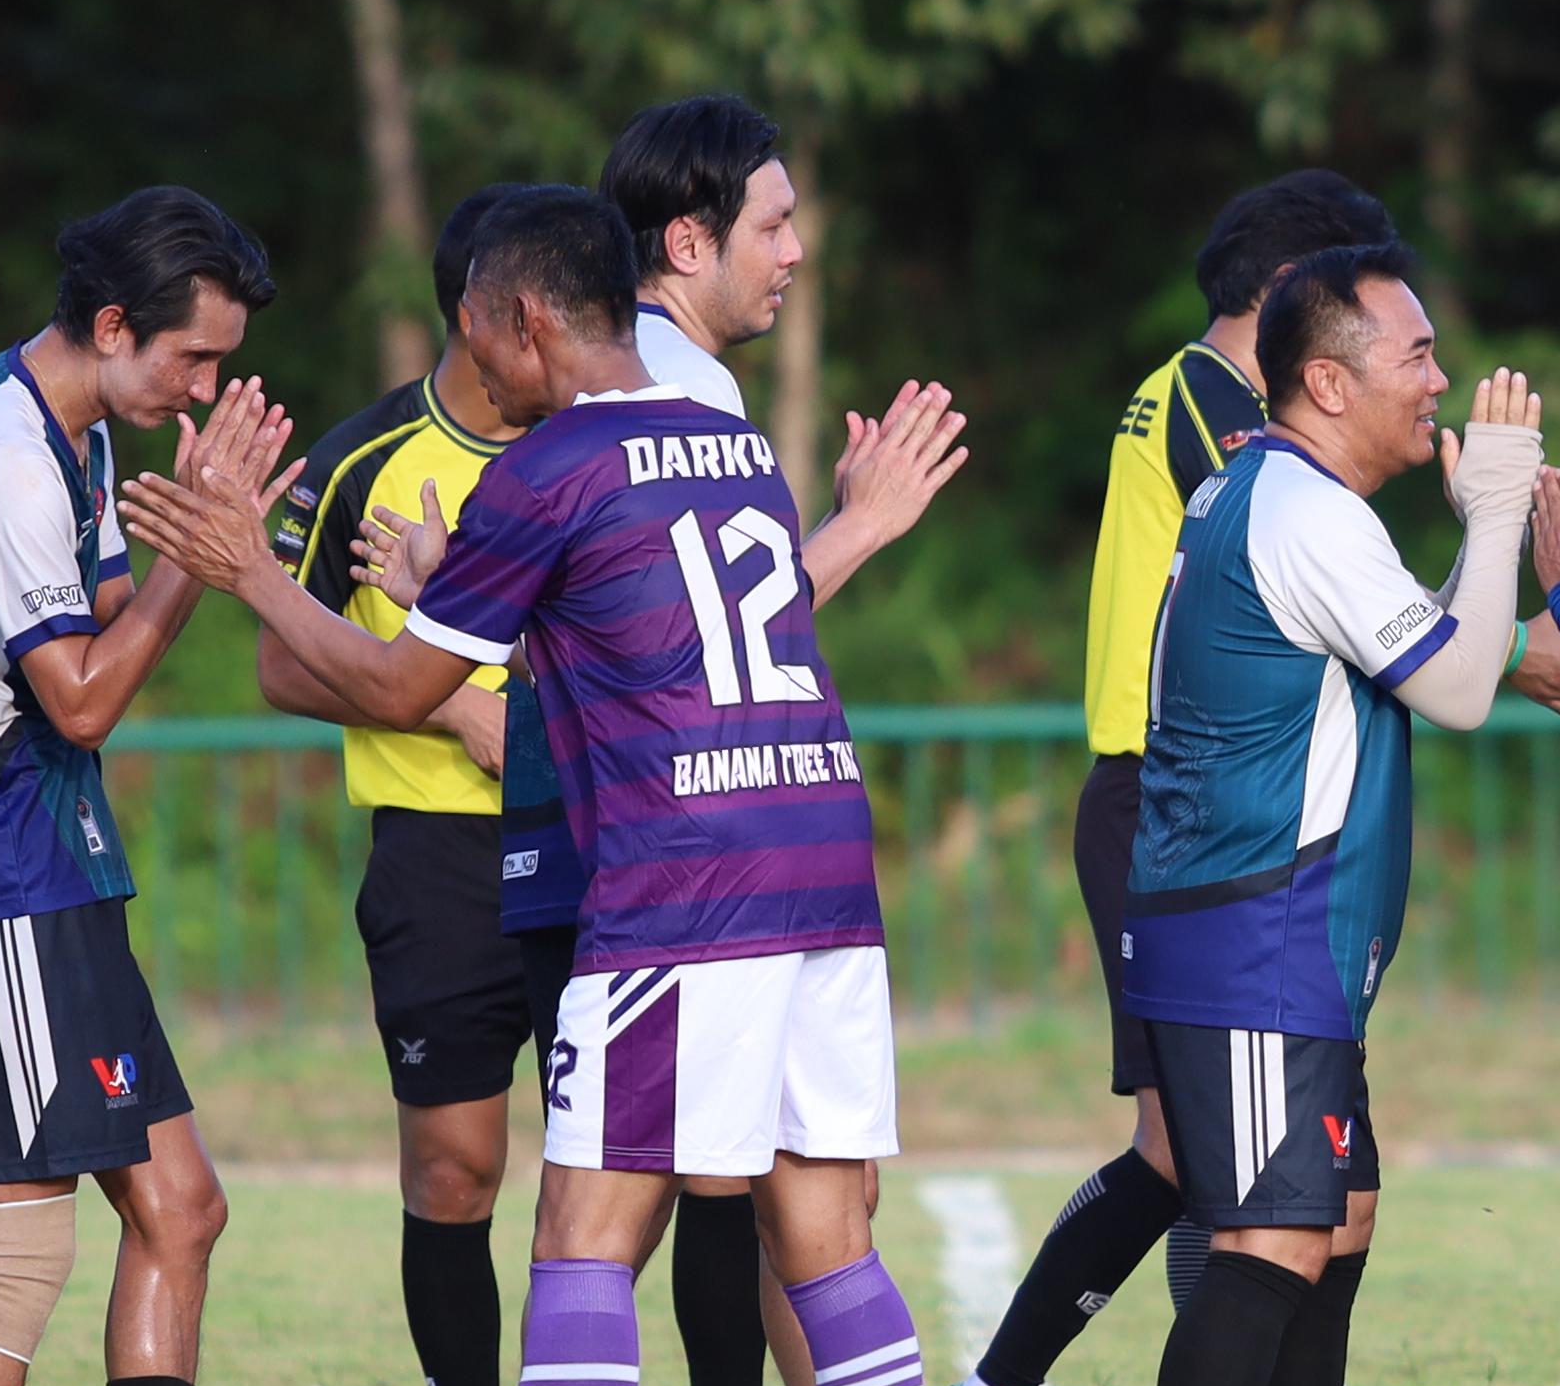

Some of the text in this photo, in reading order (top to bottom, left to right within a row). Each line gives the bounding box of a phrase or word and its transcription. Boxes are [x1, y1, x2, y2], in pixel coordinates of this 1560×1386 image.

[620, 433, 776, 485] DARKY
[669, 505, 825, 707] 12
[672, 745, 777, 797] BANANA
[778, 742, 831, 787] TREE
